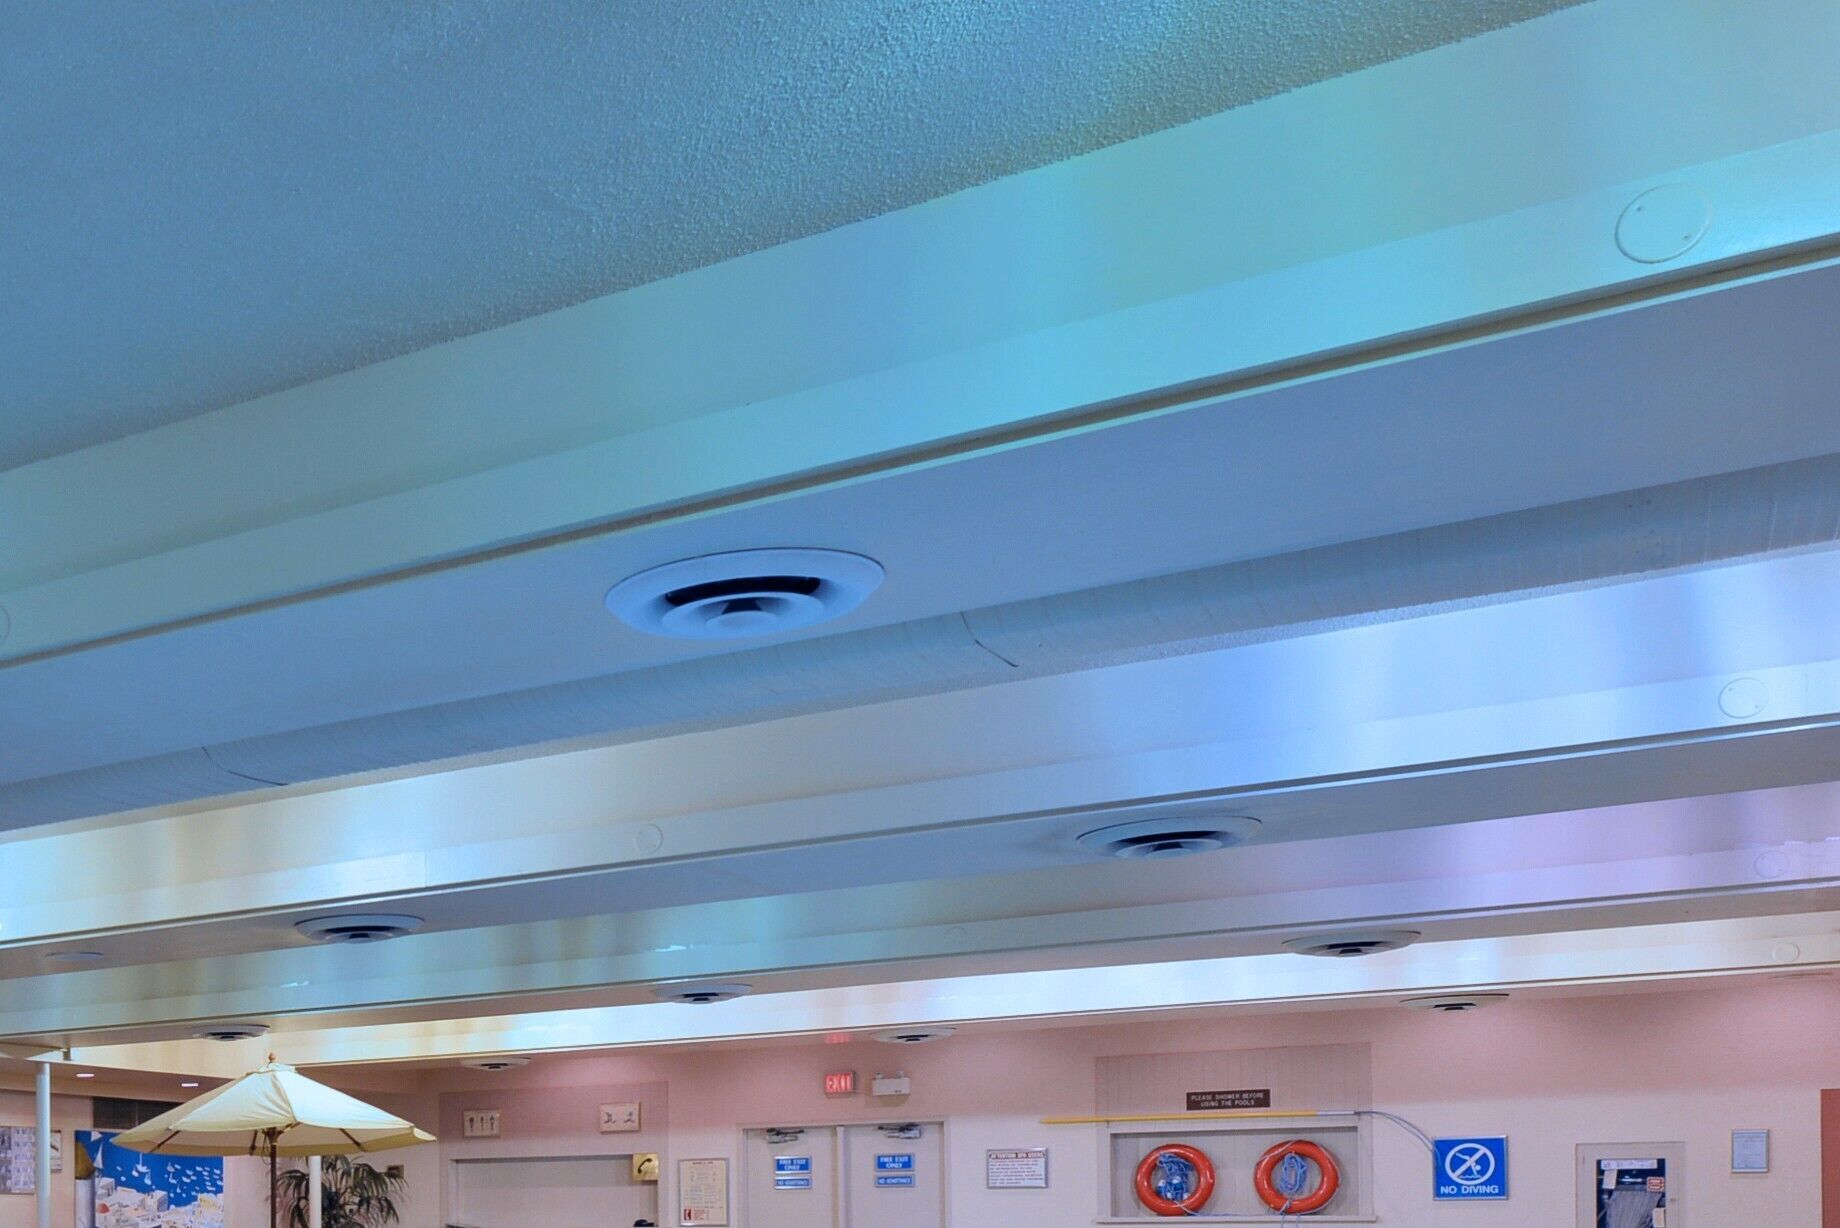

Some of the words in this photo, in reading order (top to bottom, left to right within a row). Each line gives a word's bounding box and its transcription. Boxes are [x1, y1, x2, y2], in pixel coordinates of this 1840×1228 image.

[826, 1074, 850, 1092] EXIT
[1440, 1185, 1458, 1195] NO
[1461, 1184, 1499, 1195] DIVING
